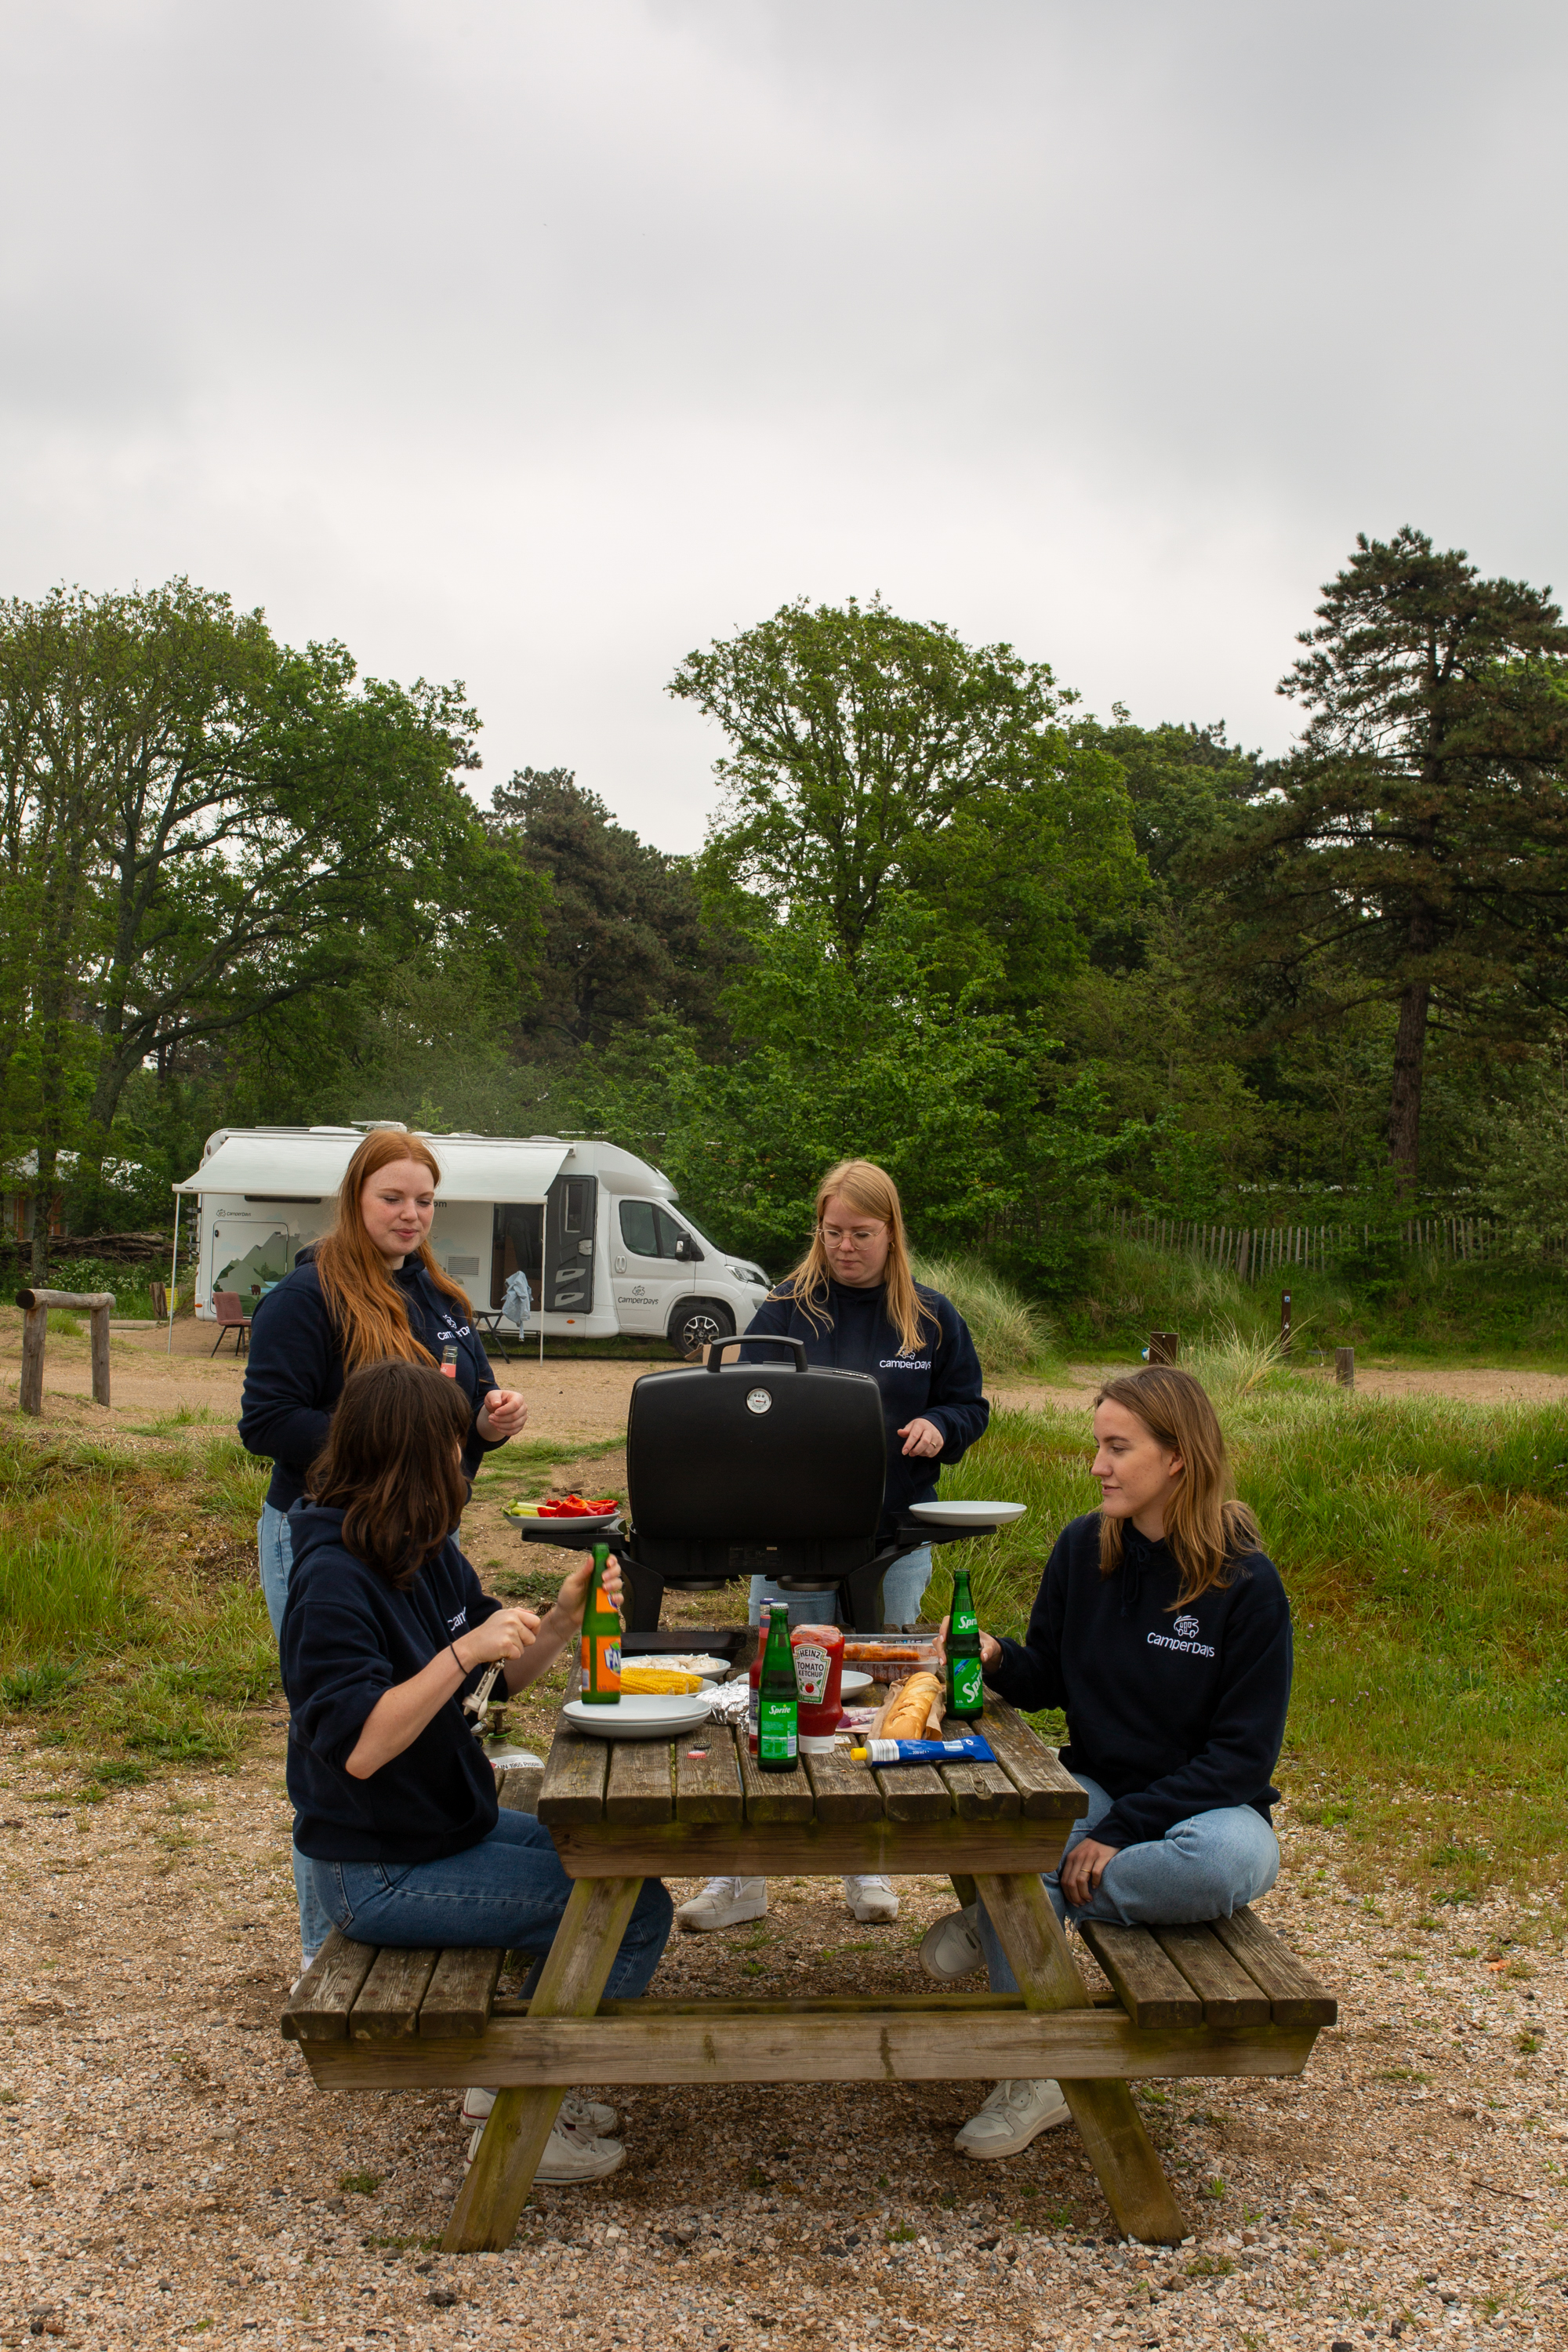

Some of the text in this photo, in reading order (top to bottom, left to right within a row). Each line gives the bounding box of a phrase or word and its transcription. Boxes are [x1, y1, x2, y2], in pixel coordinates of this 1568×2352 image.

[618, 1296, 659, 1305] CamperDays
[879, 1359, 931, 1370] CamperDays
[1147, 1632, 1215, 1657] CamperDays
[800, 1649, 821, 1659] HEINZ
[797, 1661, 824, 1671] TOMATO
[768, 1704, 792, 1715] Sprite
